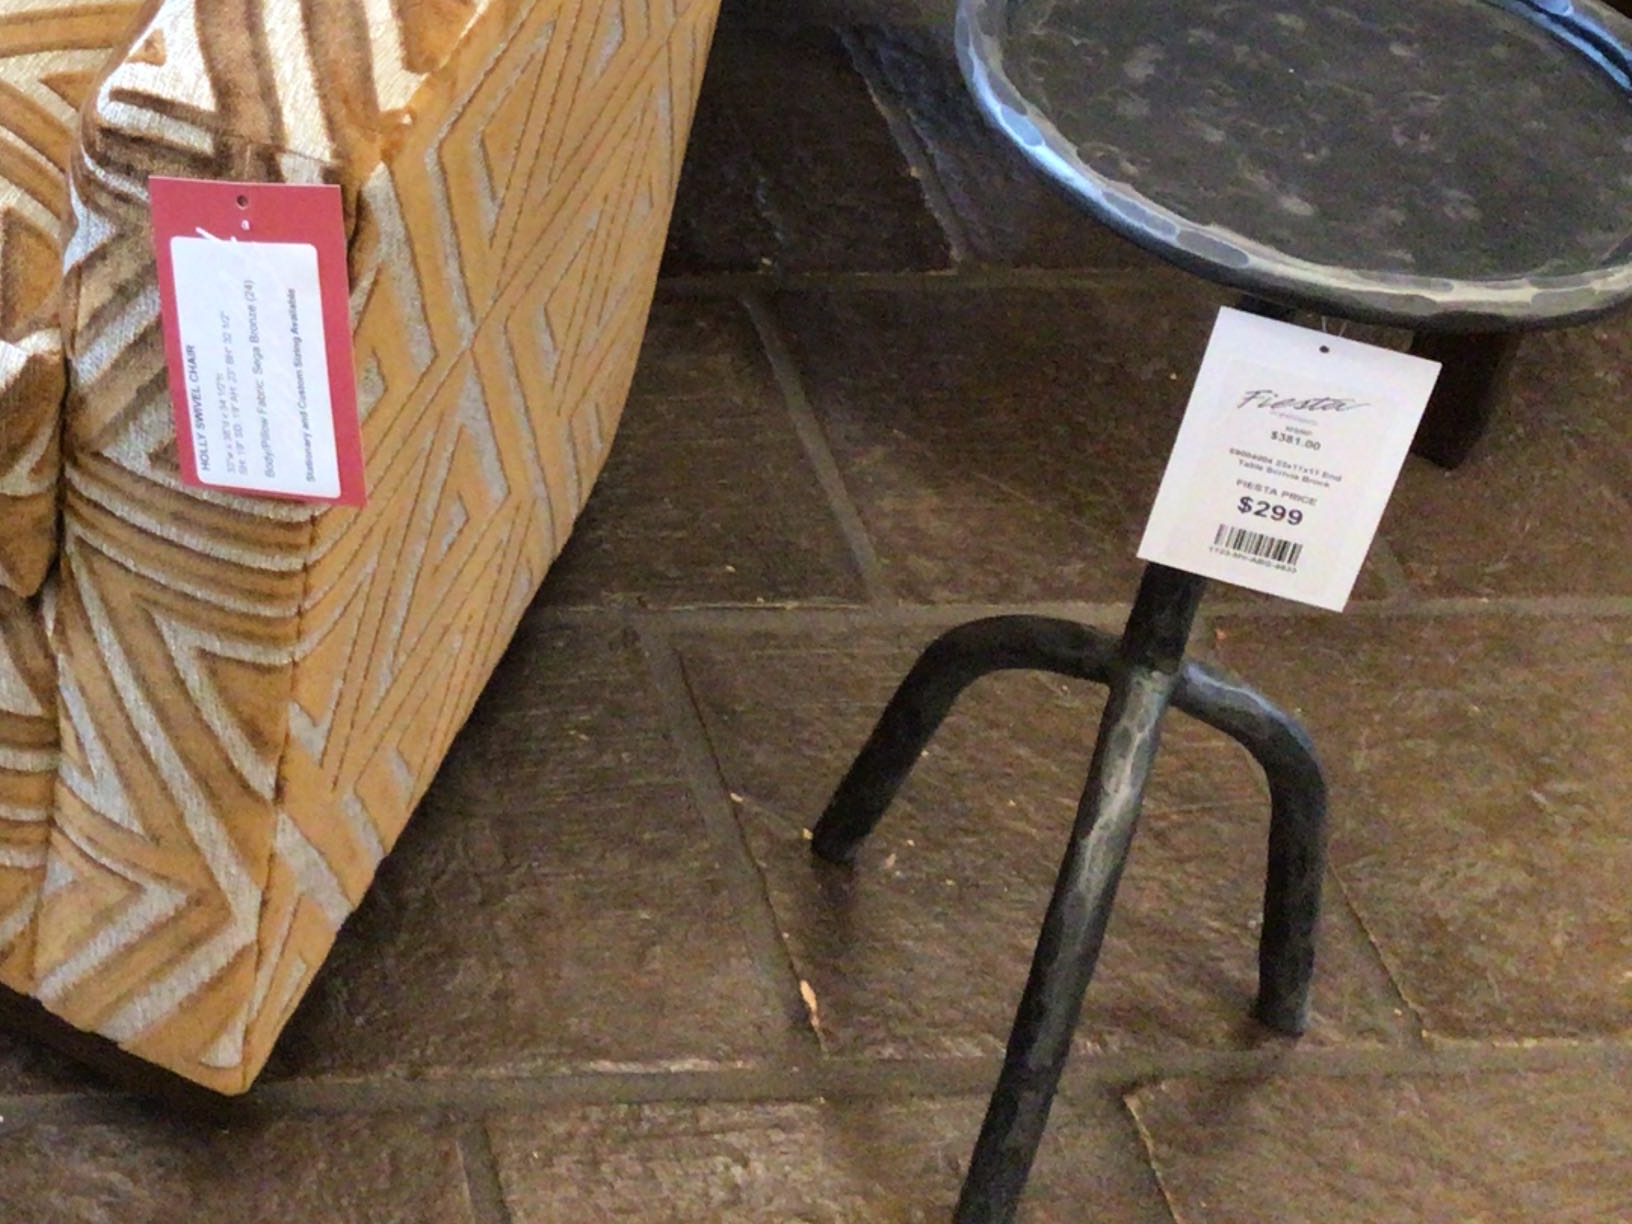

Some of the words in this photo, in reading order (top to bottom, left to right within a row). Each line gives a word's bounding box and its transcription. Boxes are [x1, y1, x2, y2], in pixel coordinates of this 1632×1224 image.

[243, 280, 257, 301] (24)
[247, 304, 260, 343] Bronze
[287, 288, 298, 334] Available
[185, 344, 199, 382] CHAIR
[292, 337, 303, 367] Sizing
[295, 370, 306, 408] Custom
[1237, 389, 1371, 411] Fiesta
[191, 385, 205, 430] SWIVEL
[298, 411, 310, 430] and
[196, 432, 210, 471] HOLLY
[303, 432, 316, 482] Stationary
[1270, 431, 1321, 451] $381.00
[1236, 479, 1278, 495] FIESTA
[1280, 490, 1318, 505] PRICE
[1237, 496, 1304, 526] $299
